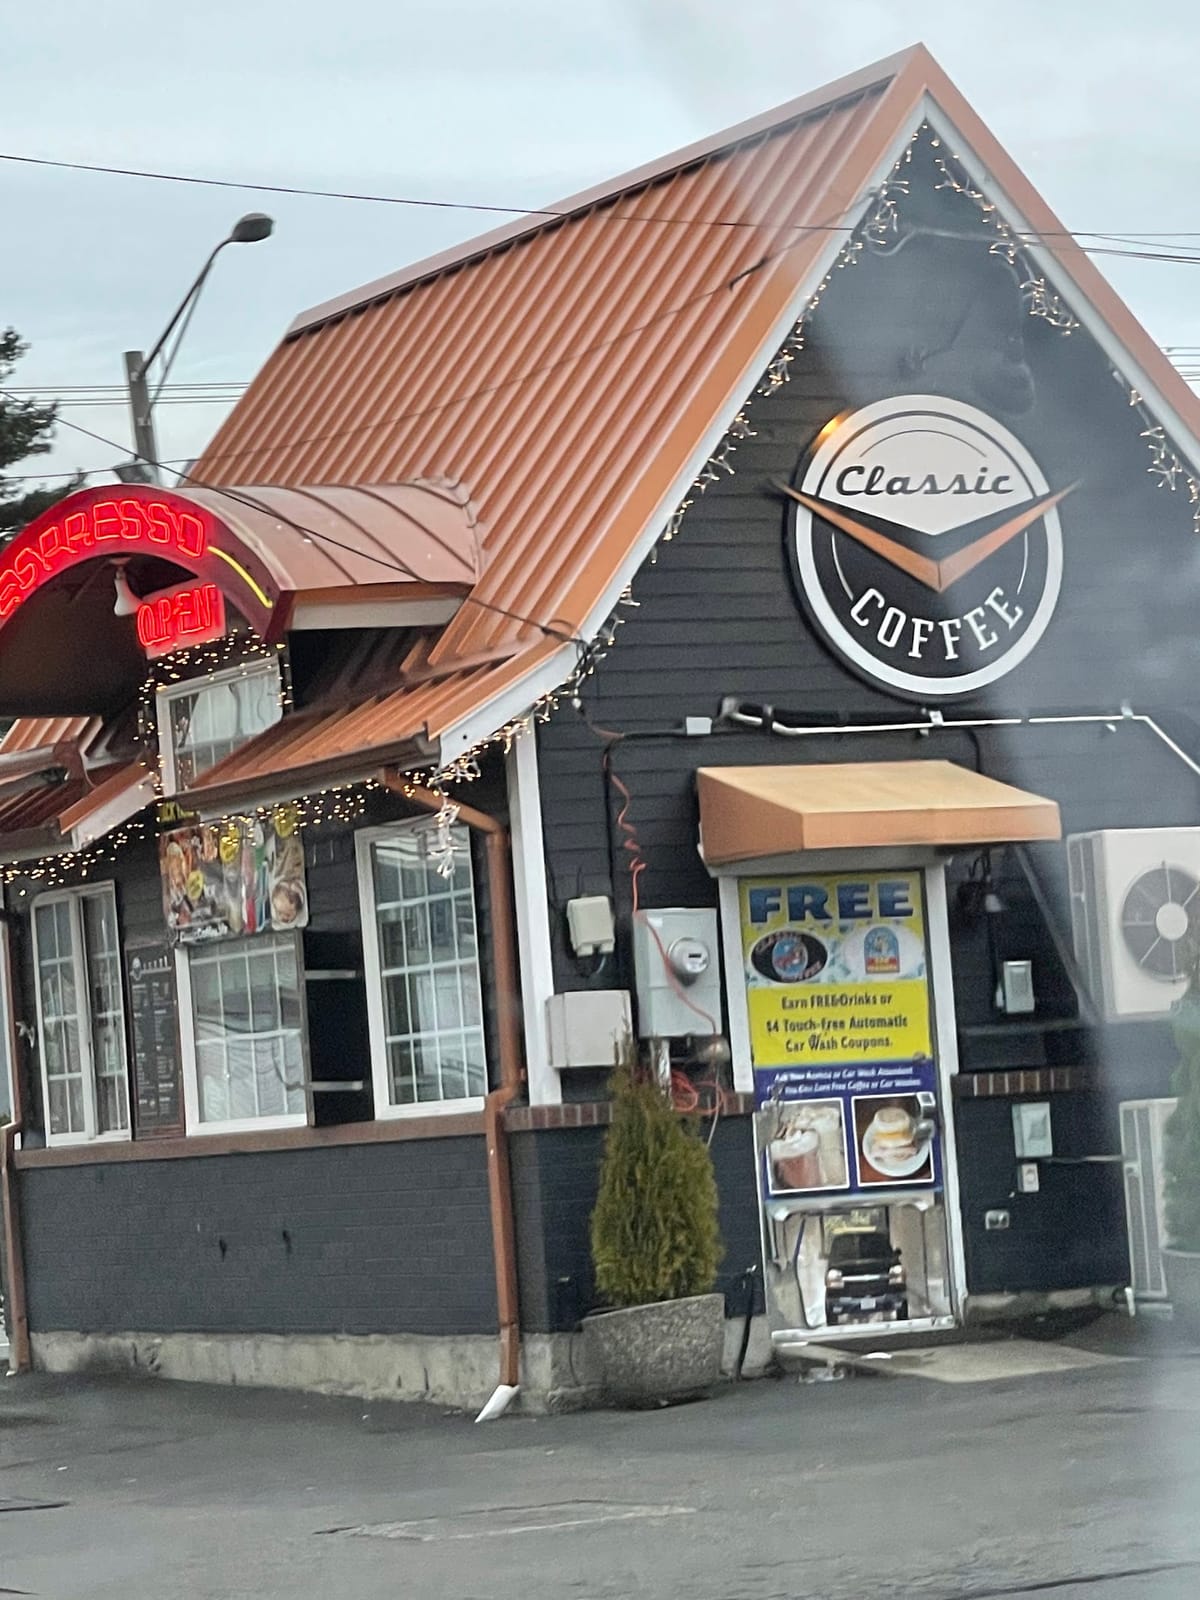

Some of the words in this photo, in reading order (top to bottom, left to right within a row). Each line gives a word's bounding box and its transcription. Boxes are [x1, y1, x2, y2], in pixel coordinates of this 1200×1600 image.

[835, 465, 1014, 496] Classic
[0, 500, 203, 617] ESPRESSO
[136, 584, 217, 647] OPEN
[850, 587, 1024, 661] COFFEE
[749, 882, 914, 923] FREE
[781, 996, 808, 1010] Earn
[840, 992, 877, 1007] Drinks
[880, 994, 893, 1005] or
[849, 1014, 908, 1030] Automatic
[785, 1039, 805, 1052] Car
[808, 1034, 838, 1051] Wash
